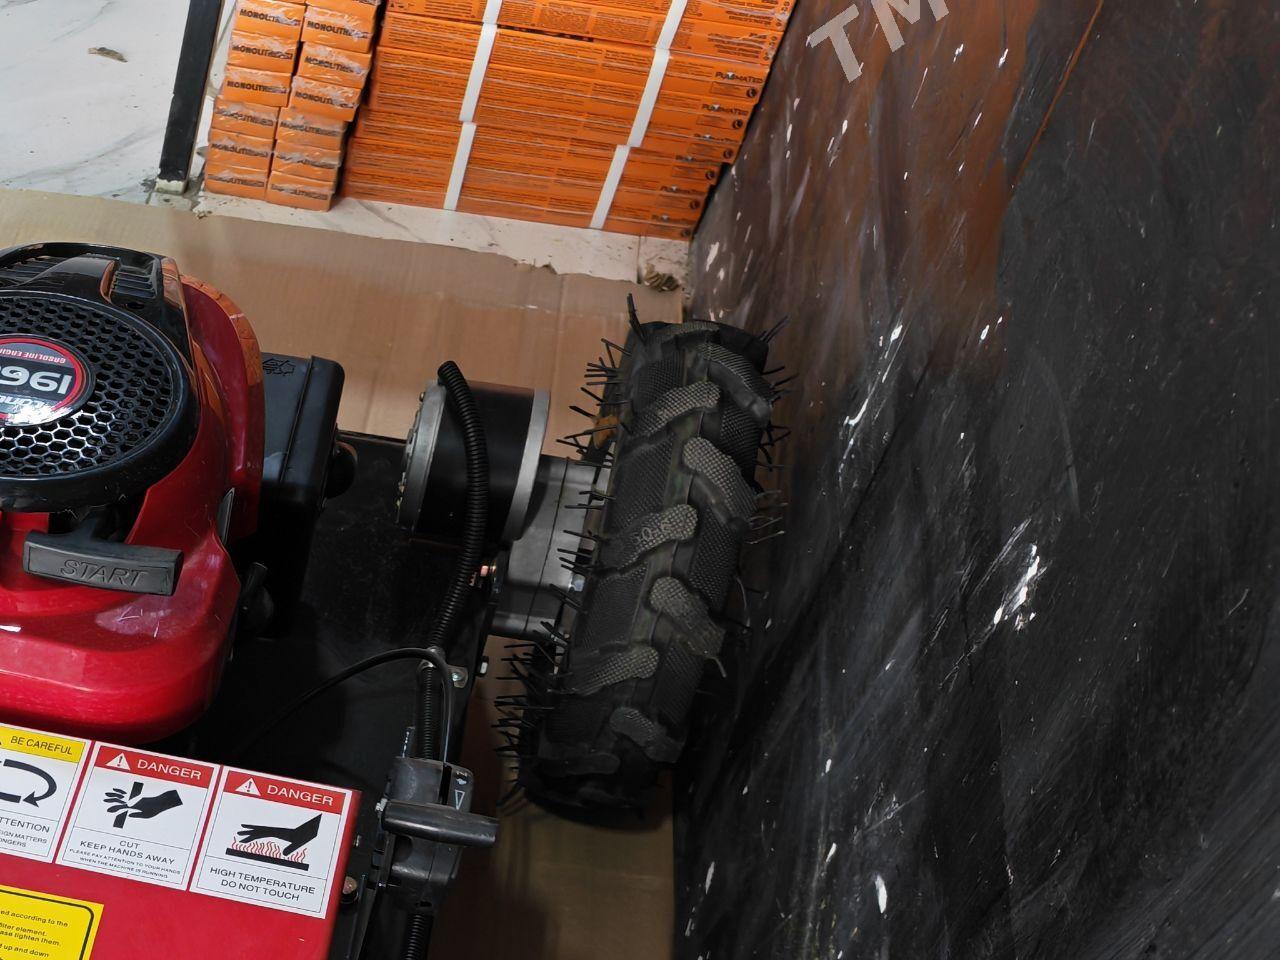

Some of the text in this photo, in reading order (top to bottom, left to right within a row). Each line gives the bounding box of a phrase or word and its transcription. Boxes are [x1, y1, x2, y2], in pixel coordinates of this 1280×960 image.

[23, 351, 66, 364] GASOLINE
[60, 559, 148, 587] START
[9, 735, 74, 755] BE CAREFUL
[136, 758, 202, 780] DANGER
[266, 784, 334, 806] DANGER
[13, 832, 48, 844] MATTERS
[118, 839, 140, 850] CUT
[78, 839, 175, 865] KEEP HANDS AWAY
[208, 866, 316, 895] HIGH TEMPERATURE
[220, 878, 300, 901] DO NOT TOUCH
